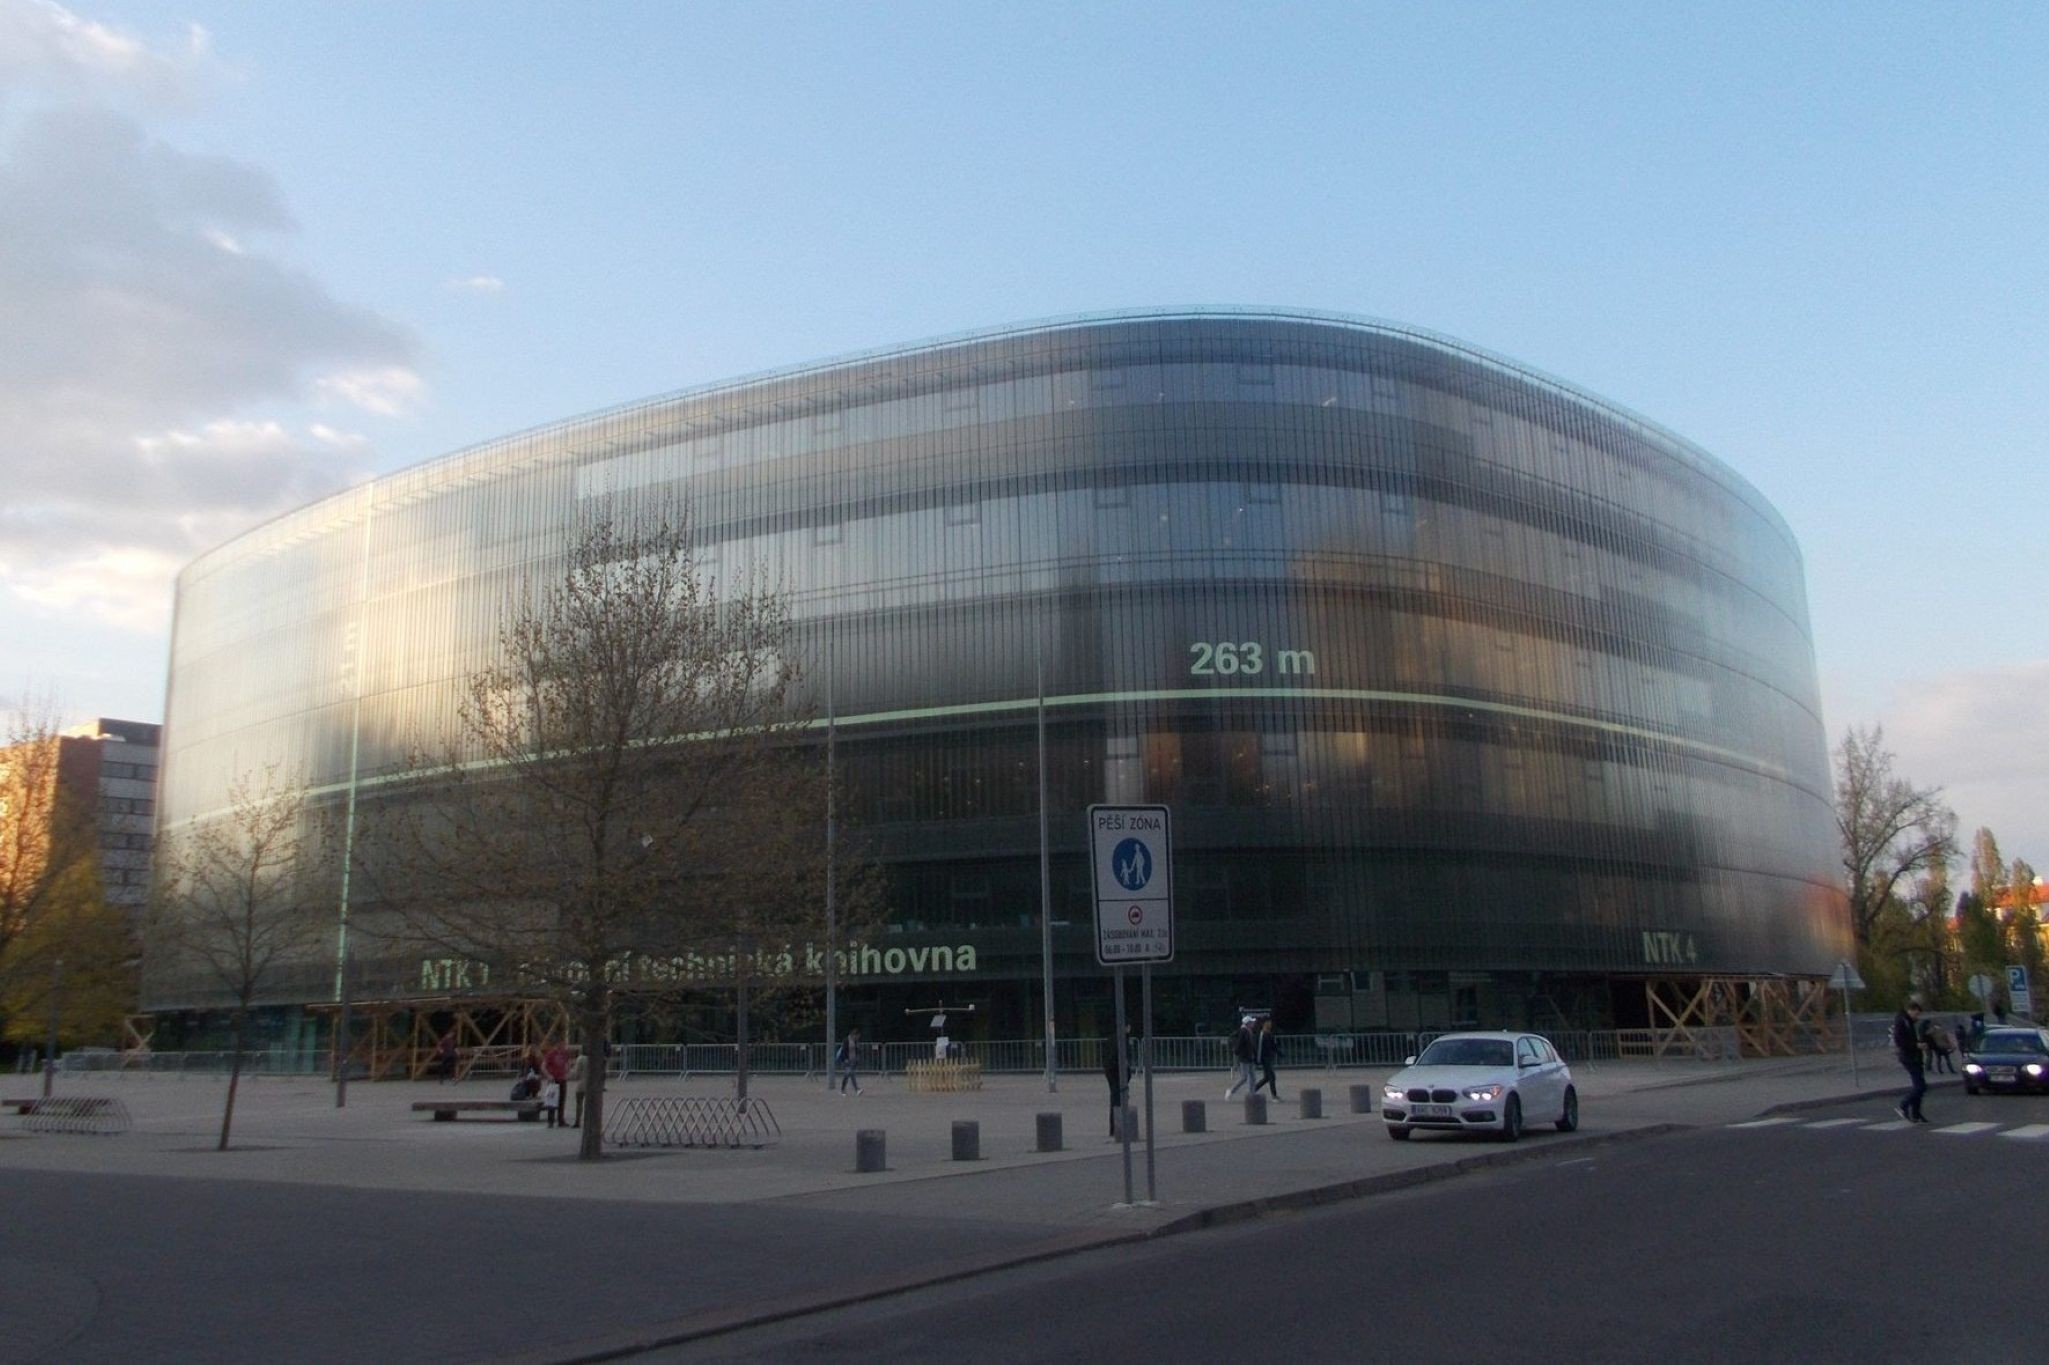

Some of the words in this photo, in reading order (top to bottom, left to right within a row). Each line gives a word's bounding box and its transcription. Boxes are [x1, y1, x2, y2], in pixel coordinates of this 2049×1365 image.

[1190, 641, 1263, 675] 263
[1278, 648, 1315, 675] m
[1642, 931, 1683, 963] NTK
[1686, 935, 1697, 966] 4
[421, 958, 472, 990] NTK
